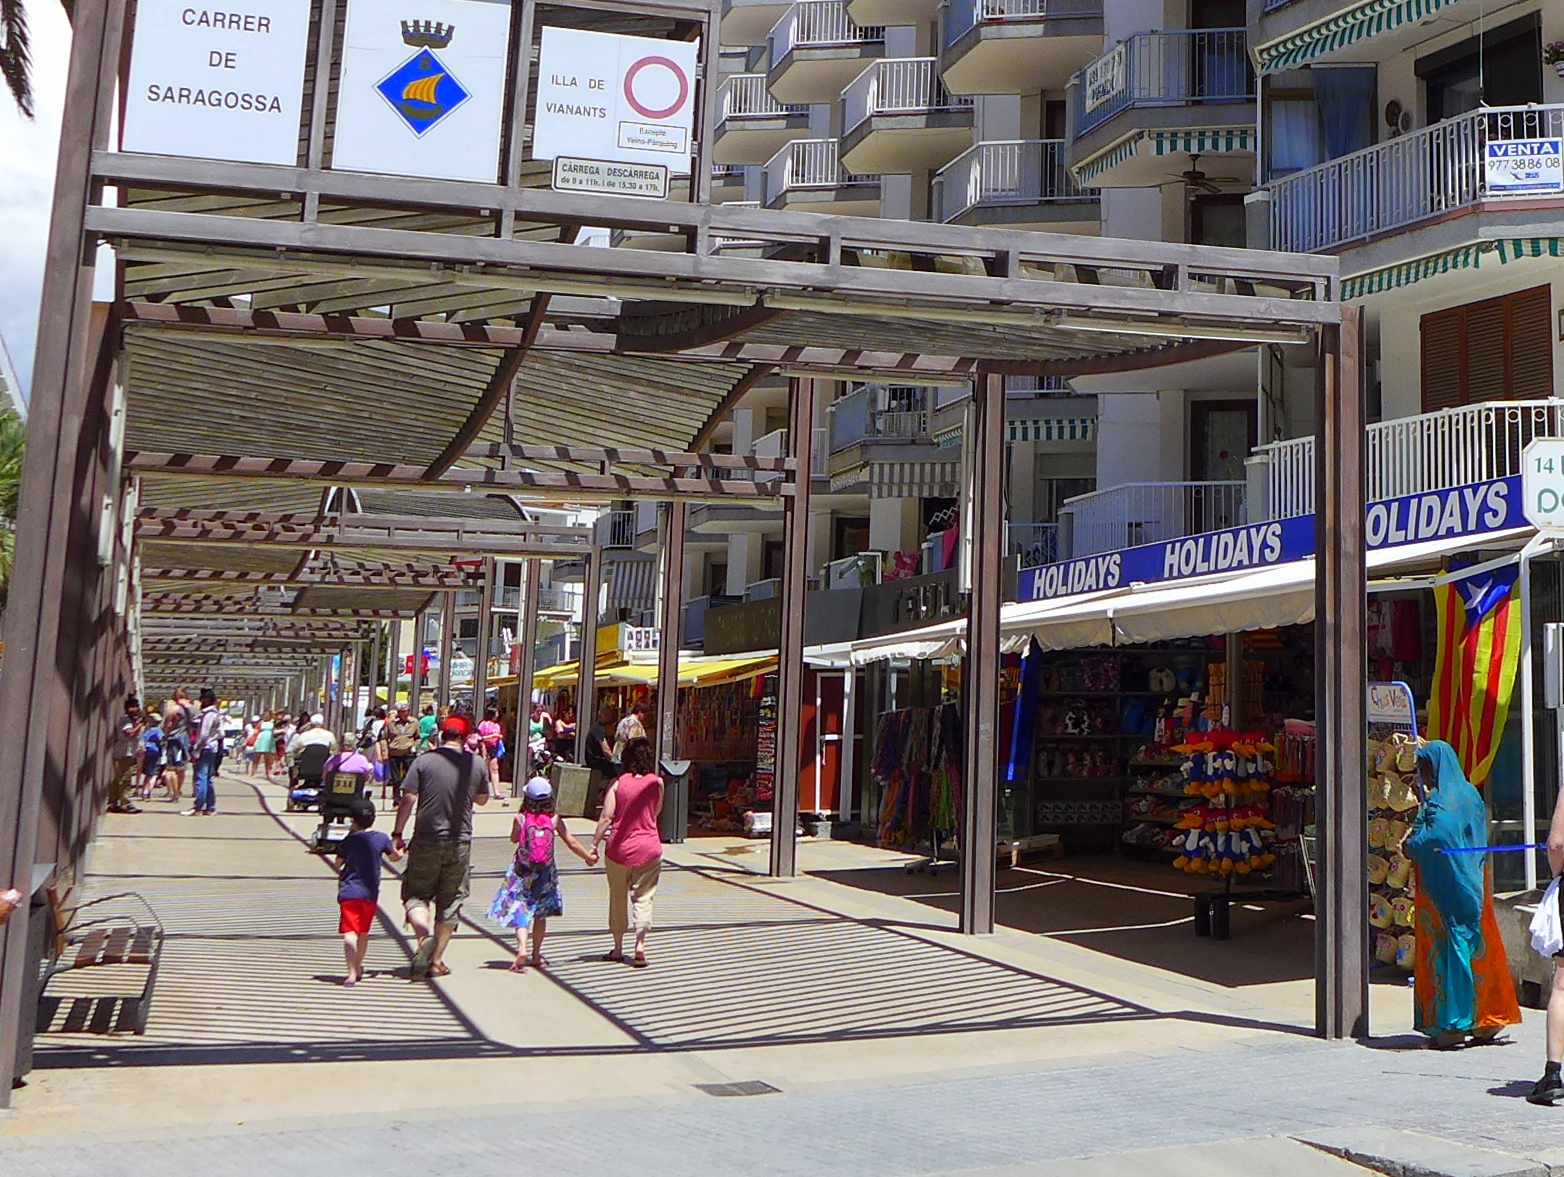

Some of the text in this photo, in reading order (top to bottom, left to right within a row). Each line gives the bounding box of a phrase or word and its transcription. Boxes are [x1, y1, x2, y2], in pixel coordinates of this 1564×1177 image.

[182, 8, 271, 34] CARRER
[209, 50, 237, 70] DE
[551, 74, 605, 90] ILLA DE
[147, 84, 282, 114] SARAGOSSA
[546, 102, 607, 119] VIANANTS
[1493, 142, 1554, 157] VENTA
[1534, 457, 1554, 475] 14
[1366, 481, 1508, 547] OLIDAYS
[1163, 523, 1282, 578] HOLIDAYS
[1032, 554, 1121, 599] HOLIDAYS
